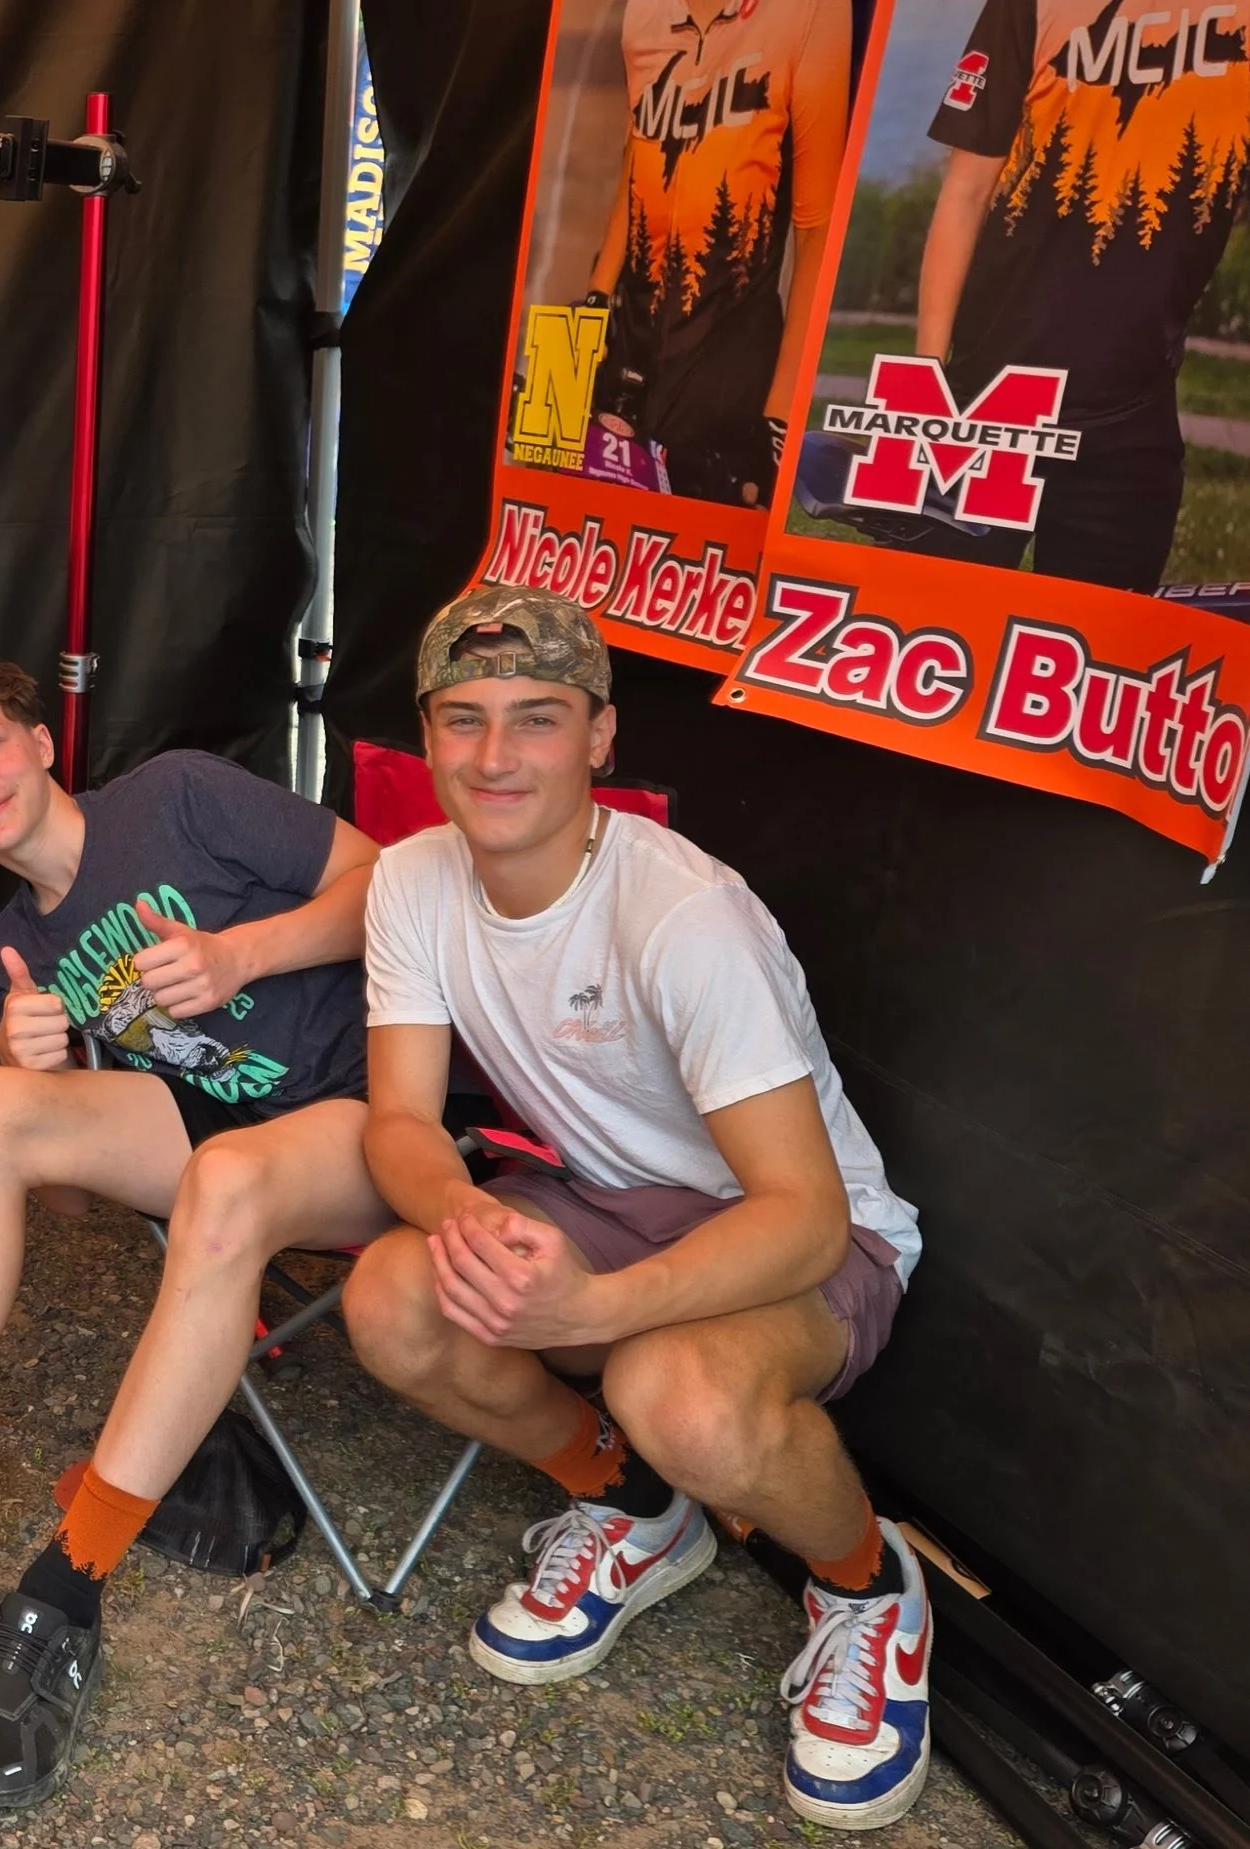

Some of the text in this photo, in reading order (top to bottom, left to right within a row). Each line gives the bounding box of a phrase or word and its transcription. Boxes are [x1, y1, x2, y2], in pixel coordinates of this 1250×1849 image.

[1067, 5, 1238, 93] MCIC
[638, 52, 763, 141] MCIC
[514, 305, 609, 450] N
[513, 443, 585, 471] NEGAUNEE
[603, 432, 631, 468] 21
[828, 408, 1078, 455] MARQUETTE
[844, 353, 1069, 532] M
[484, 503, 757, 650] Nicole Kerke
[745, 581, 1248, 814] Zac Butto
